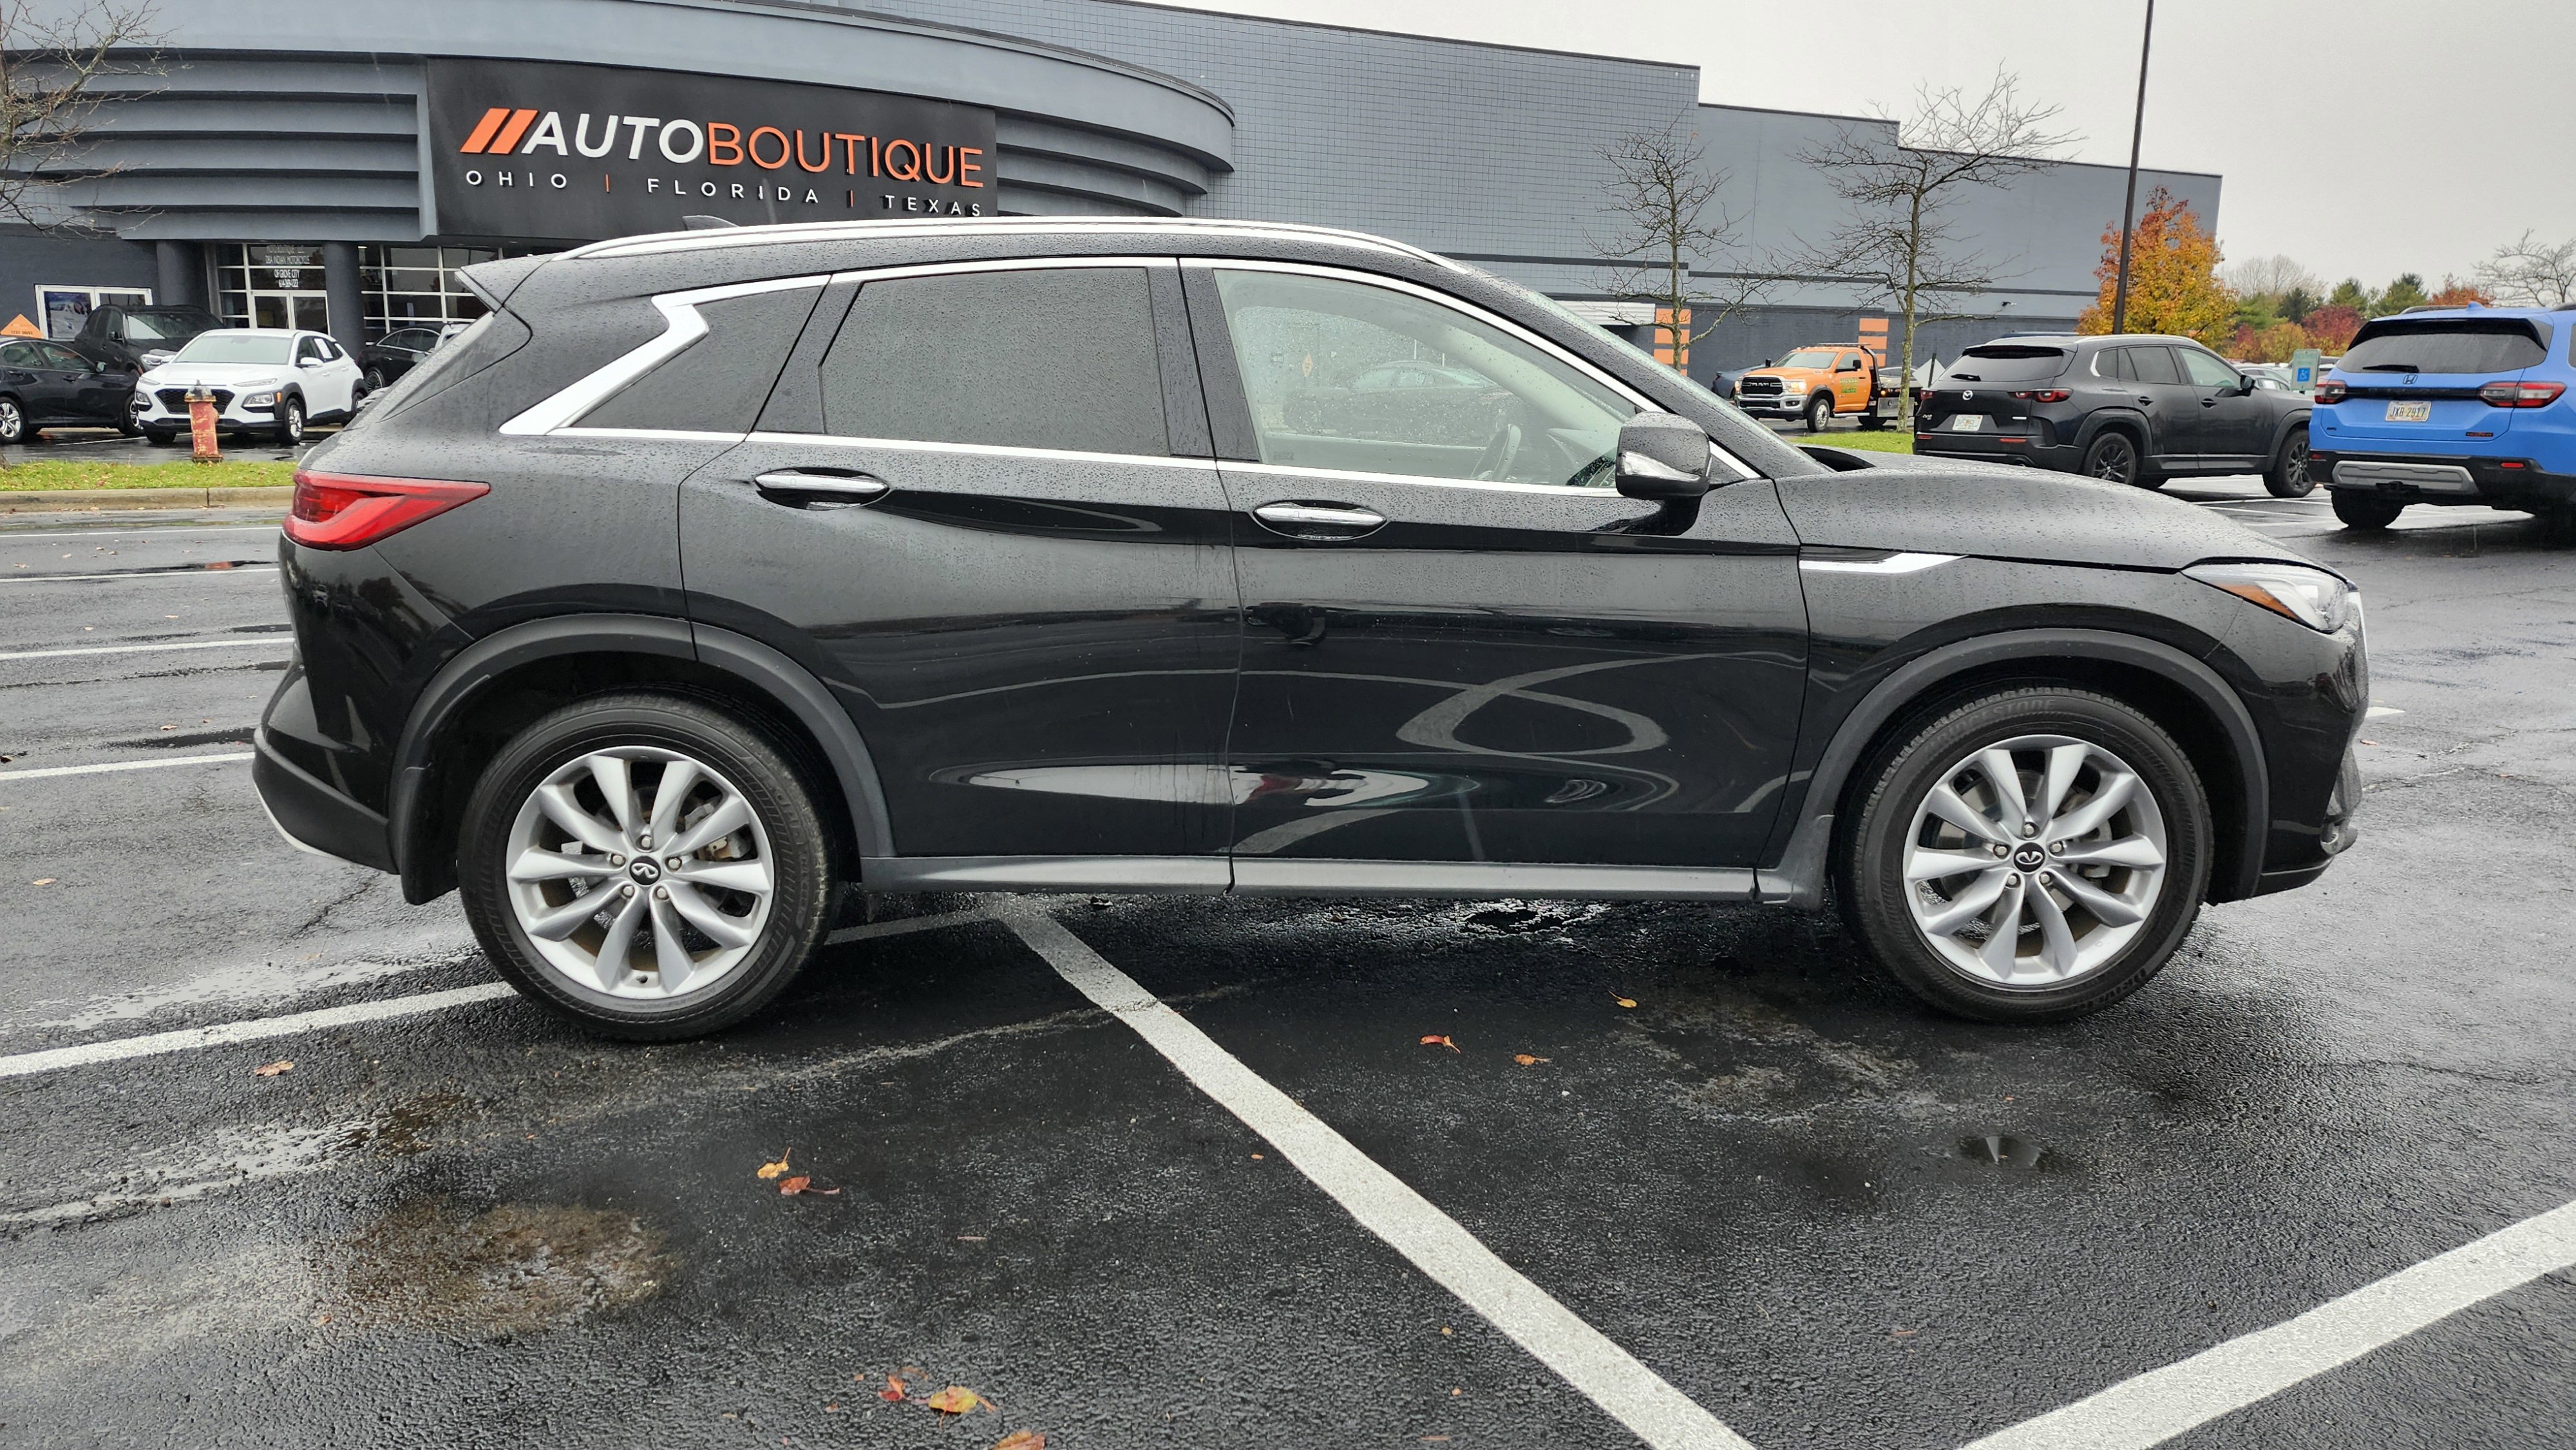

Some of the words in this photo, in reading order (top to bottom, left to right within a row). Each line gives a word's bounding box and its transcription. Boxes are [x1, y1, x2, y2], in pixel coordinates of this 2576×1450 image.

[520, 111, 985, 188] AUTOBOUTIQUE
[466, 169, 567, 189] OHIO
[648, 178, 819, 203] FLORIDA
[885, 194, 981, 217] TEXAS
[2406, 407, 2427, 418] 2917
